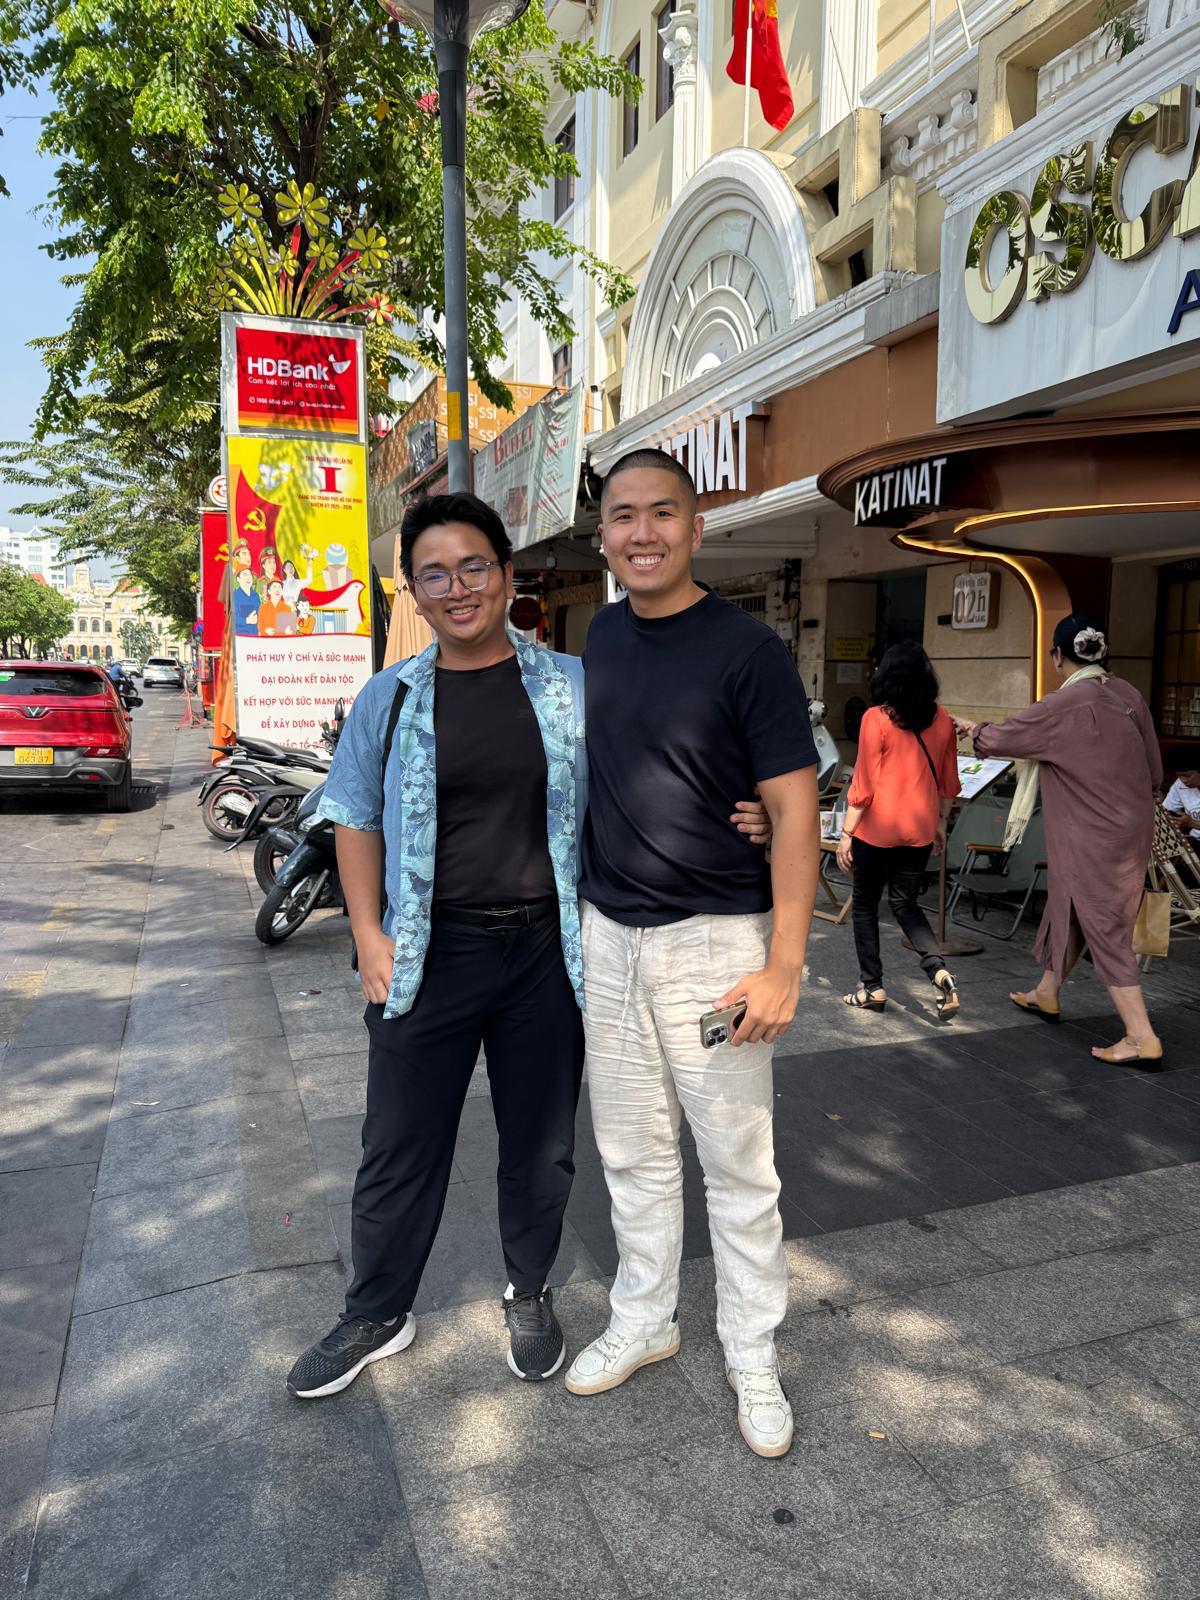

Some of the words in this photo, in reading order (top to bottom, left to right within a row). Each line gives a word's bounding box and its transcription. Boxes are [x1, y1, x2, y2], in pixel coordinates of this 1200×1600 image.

[965, 75, 1200, 325] OSC
[247, 356, 329, 381] HDBank
[468, 393, 478, 407] SI
[479, 407, 497, 419] SSI
[468, 416, 479, 429] SI
[479, 429, 497, 442] SSI
[656, 402, 752, 495] TINAT
[319, 466, 343, 493] I
[854, 457, 947, 526] KATINAT
[246, 652, 267, 662] PHÁT
[269, 654, 286, 662] HUY
[288, 652, 293, 662] Ý
[295, 651, 310, 662] CHÍ
[312, 652, 324, 662] VÀ
[325, 652, 341, 662] SỨC
[343, 654, 366, 664] MẠNH
[261, 676, 276, 686] ĐẠI
[278, 674, 302, 684] ĐOÀN
[304, 673, 317, 684] KẾT
[320, 674, 337, 684] DÂN
[339, 674, 354, 686] TỘC
[243, 696, 257, 707] KẾT
[259, 698, 277, 708] HỢP
[278, 696, 294, 706] VỚI
[296, 696, 312, 706] SỨC
[314, 698, 337, 708] MẠNH
[261, 716, 271, 729] ĐỂ
[273, 718, 290, 728] XÂY
[292, 719, 316, 731] DỰNG
